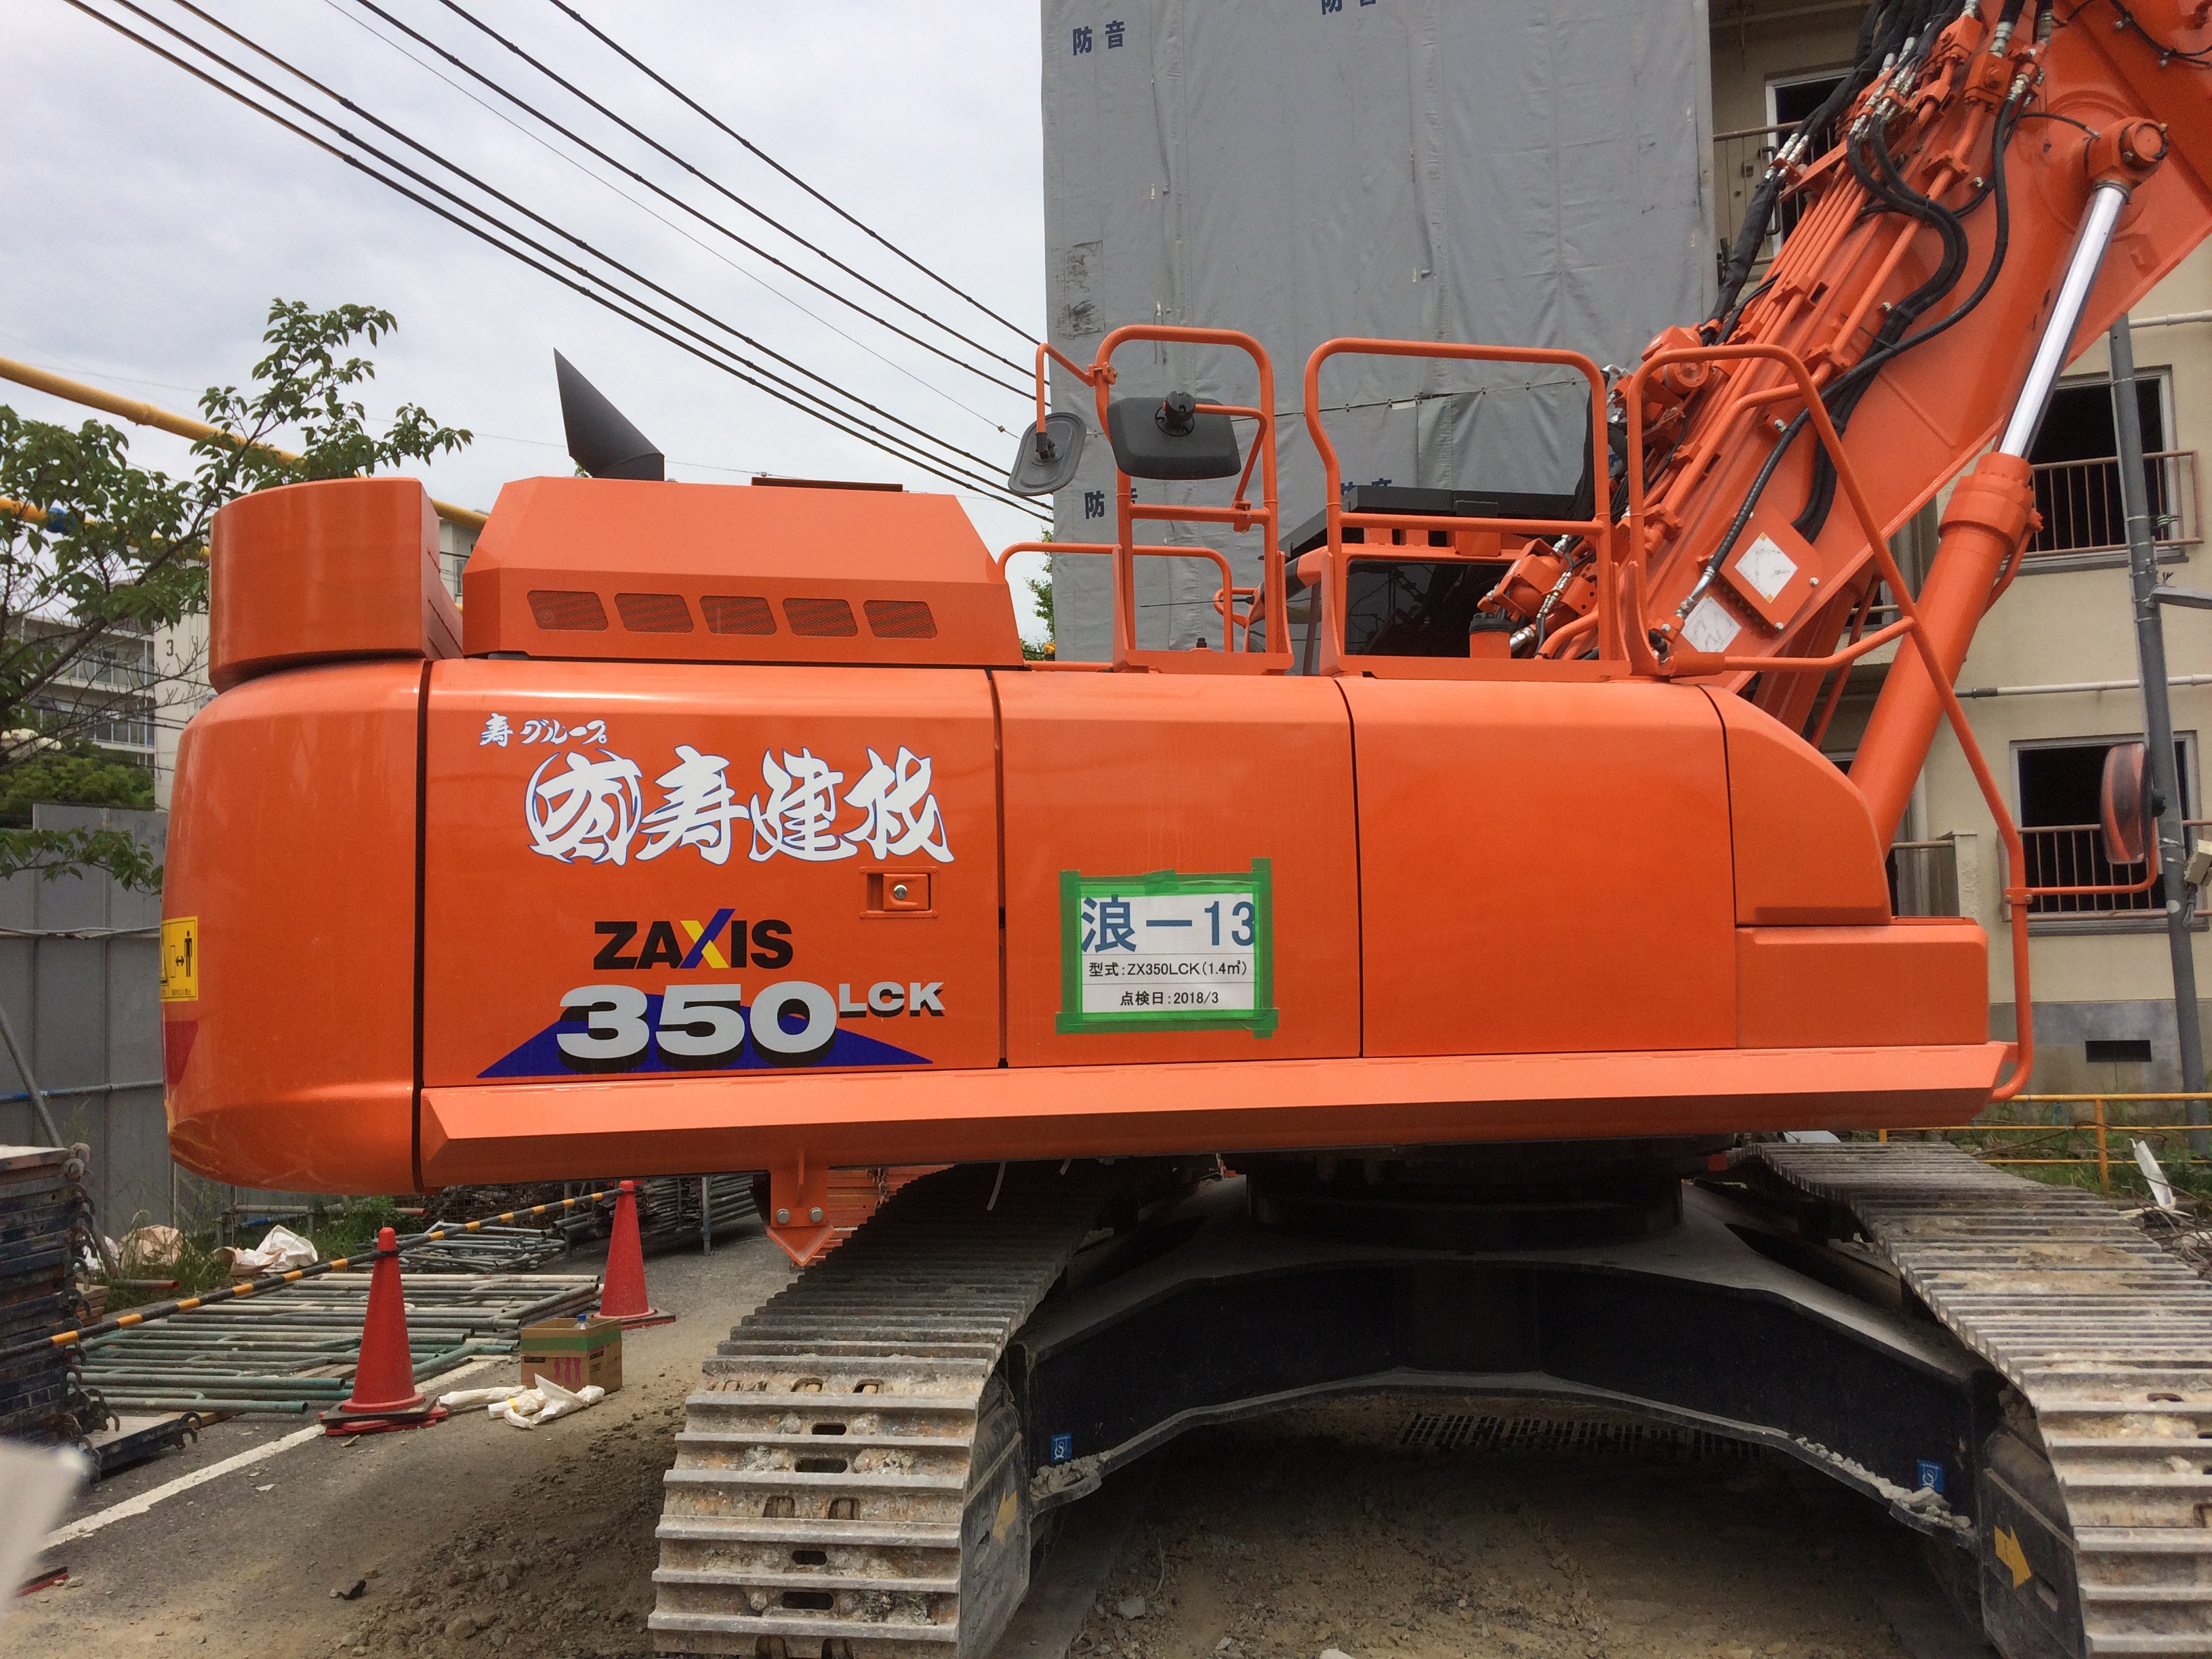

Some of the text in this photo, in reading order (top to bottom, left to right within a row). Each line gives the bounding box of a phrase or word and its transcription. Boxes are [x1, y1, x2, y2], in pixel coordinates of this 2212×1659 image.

[1073, 20, 1125, 56] 防音
[166, 639, 173, 656] 3
[593, 908, 793, 969] ZAXIS
